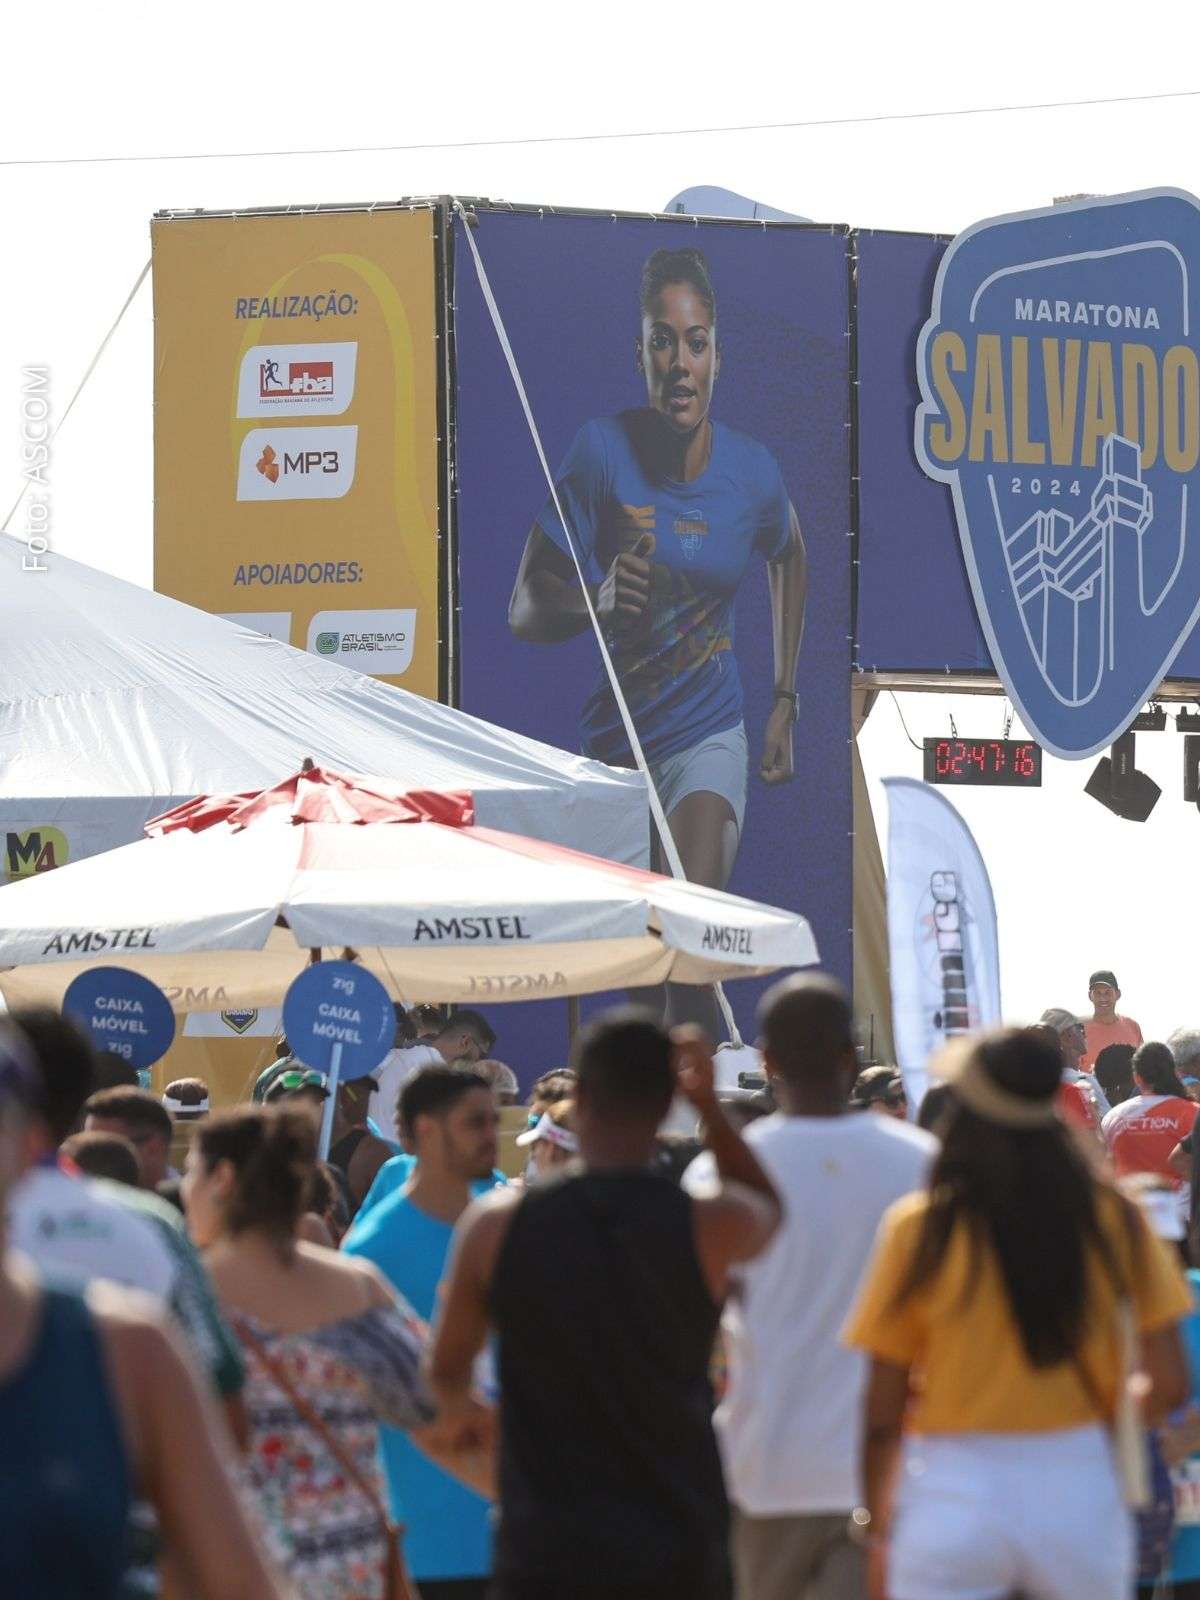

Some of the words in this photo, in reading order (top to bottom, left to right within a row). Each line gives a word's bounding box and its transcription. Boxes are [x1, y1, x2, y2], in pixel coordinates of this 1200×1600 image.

[236, 289, 358, 322] REALIZAÇÃO:
[1015, 298, 1160, 330] MARATONA
[283, 451, 339, 474] MP3
[1011, 478, 1081, 496] 2024
[233, 561, 364, 586] APOIADORES:
[341, 642, 383, 652] BRASIL
[342, 632, 406, 643] ATLETISMO
[935, 742, 1035, 776] 02:47:16
[413, 915, 531, 941] AMSTEL
[701, 925, 753, 954] AMSTEL
[42, 928, 157, 955] AMSTEL
[332, 977, 355, 995] zig
[95, 997, 144, 1013] CAIXA
[319, 1003, 361, 1023] CAIXA
[91, 1014, 148, 1034] MÓVEL
[312, 1021, 362, 1045] MÓVEL
